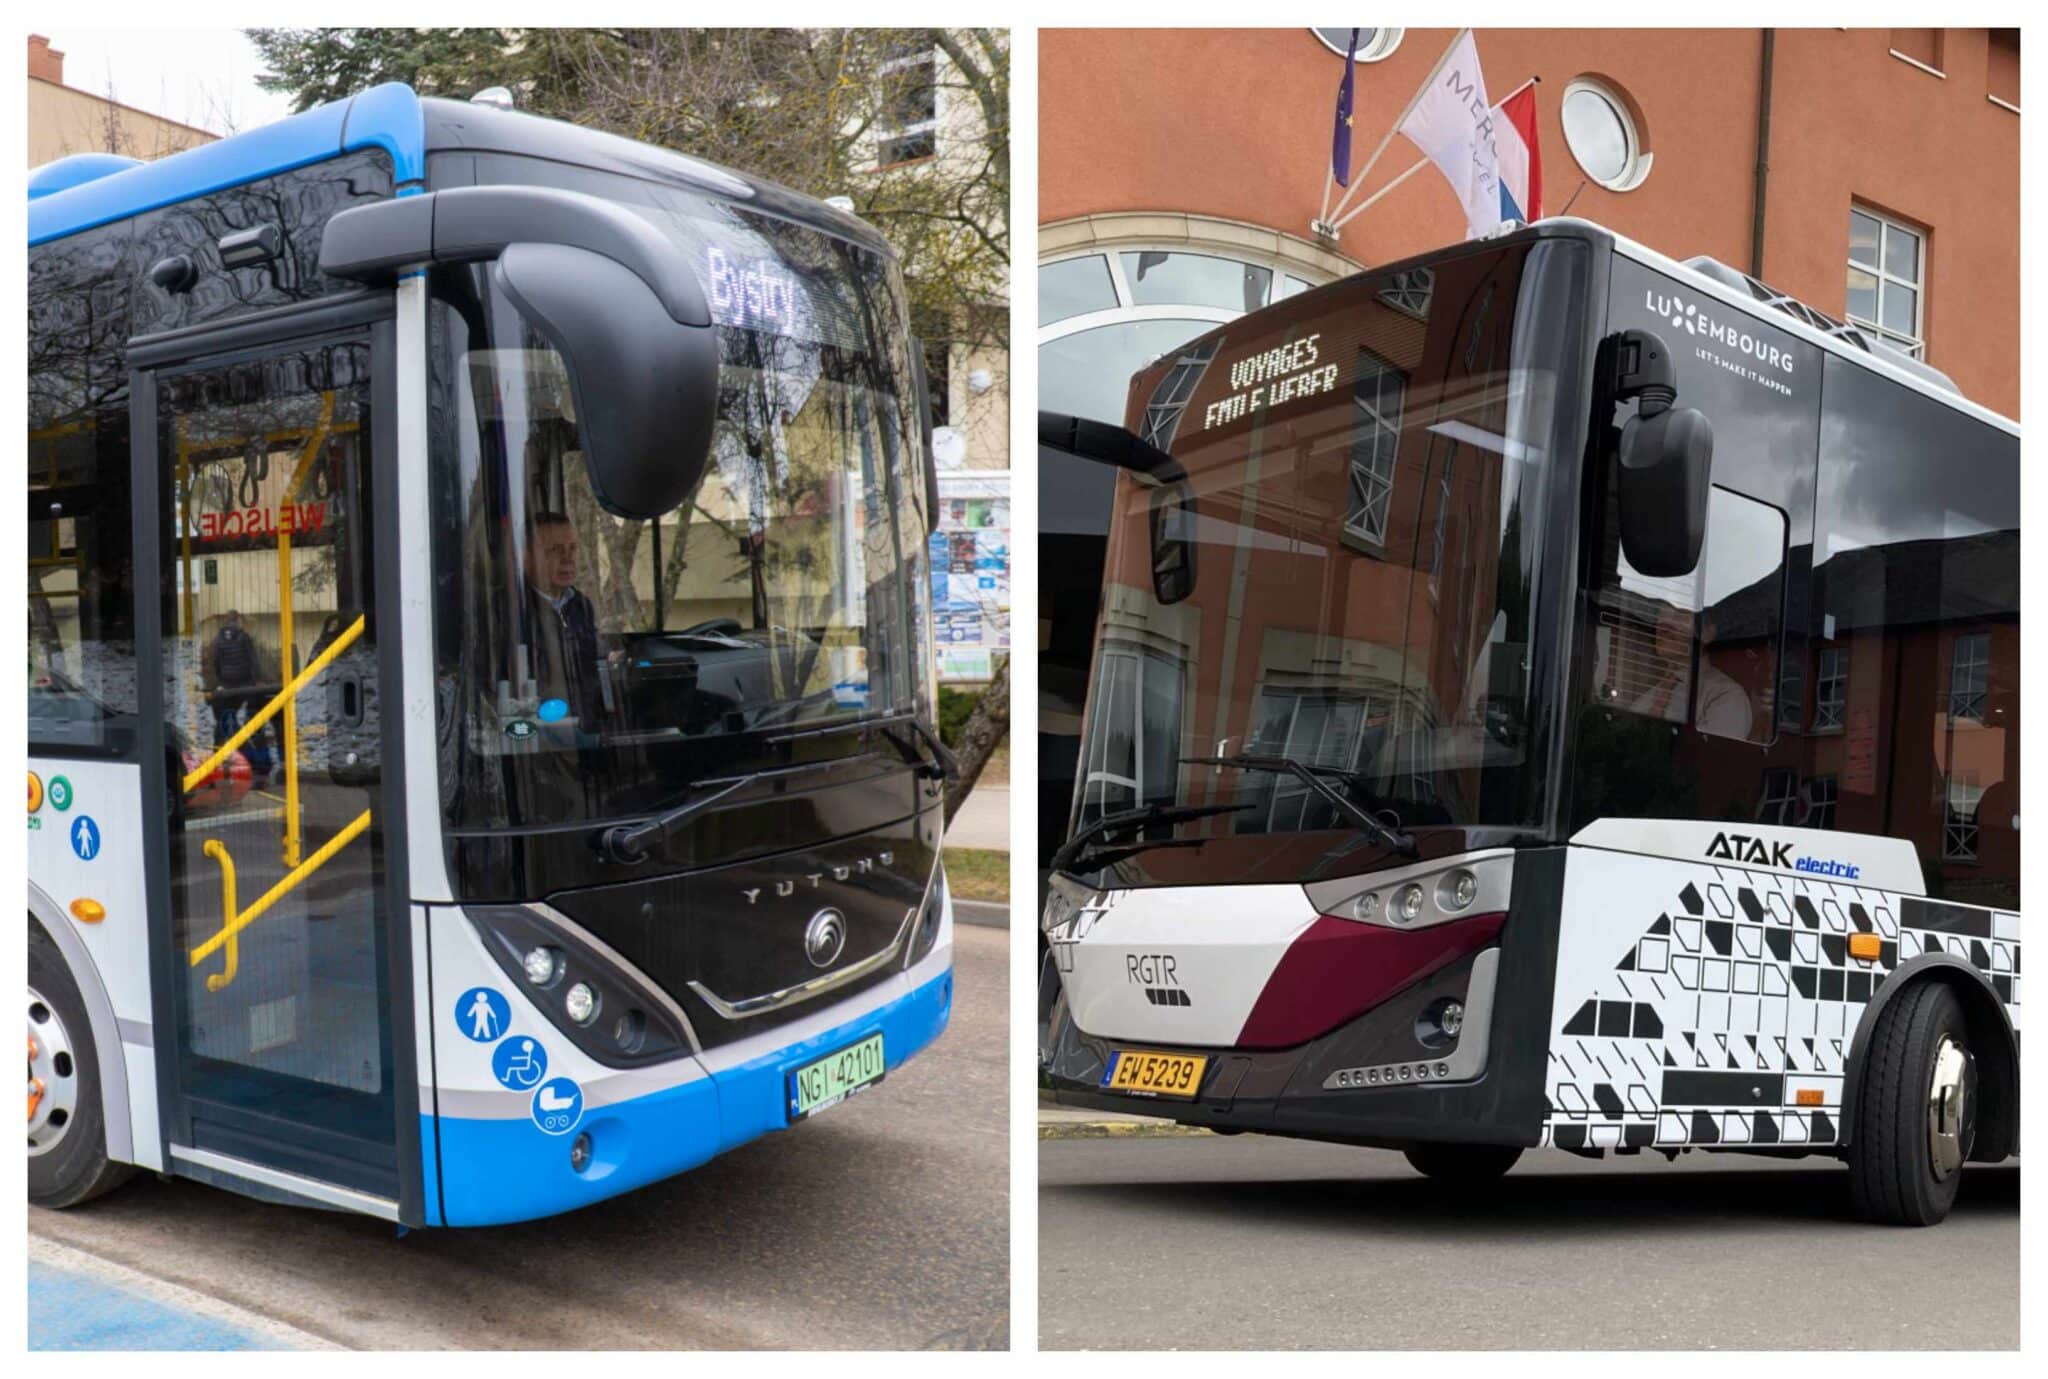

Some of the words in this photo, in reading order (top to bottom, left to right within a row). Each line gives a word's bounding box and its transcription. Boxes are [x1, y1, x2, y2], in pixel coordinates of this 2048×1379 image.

[708, 247, 793, 335] Bystry
[1646, 290, 1793, 373] LUXEMBOURG
[1231, 333, 1320, 391] VOYAGES
[1695, 347, 1720, 365] LET'S
[1721, 359, 1746, 377] MAKE
[1747, 371, 1757, 382] IT
[1758, 375, 1792, 396] HAPPEN
[743, 851, 894, 904] YUTONG
[1705, 832, 1794, 869] ATAK
[1795, 856, 1860, 879] electric
[1126, 953, 1178, 985] RGTR
[836, 1039, 880, 1088] 42101
[1117, 1056, 1144, 1085] EW
[1142, 1058, 1194, 1089] 5239
